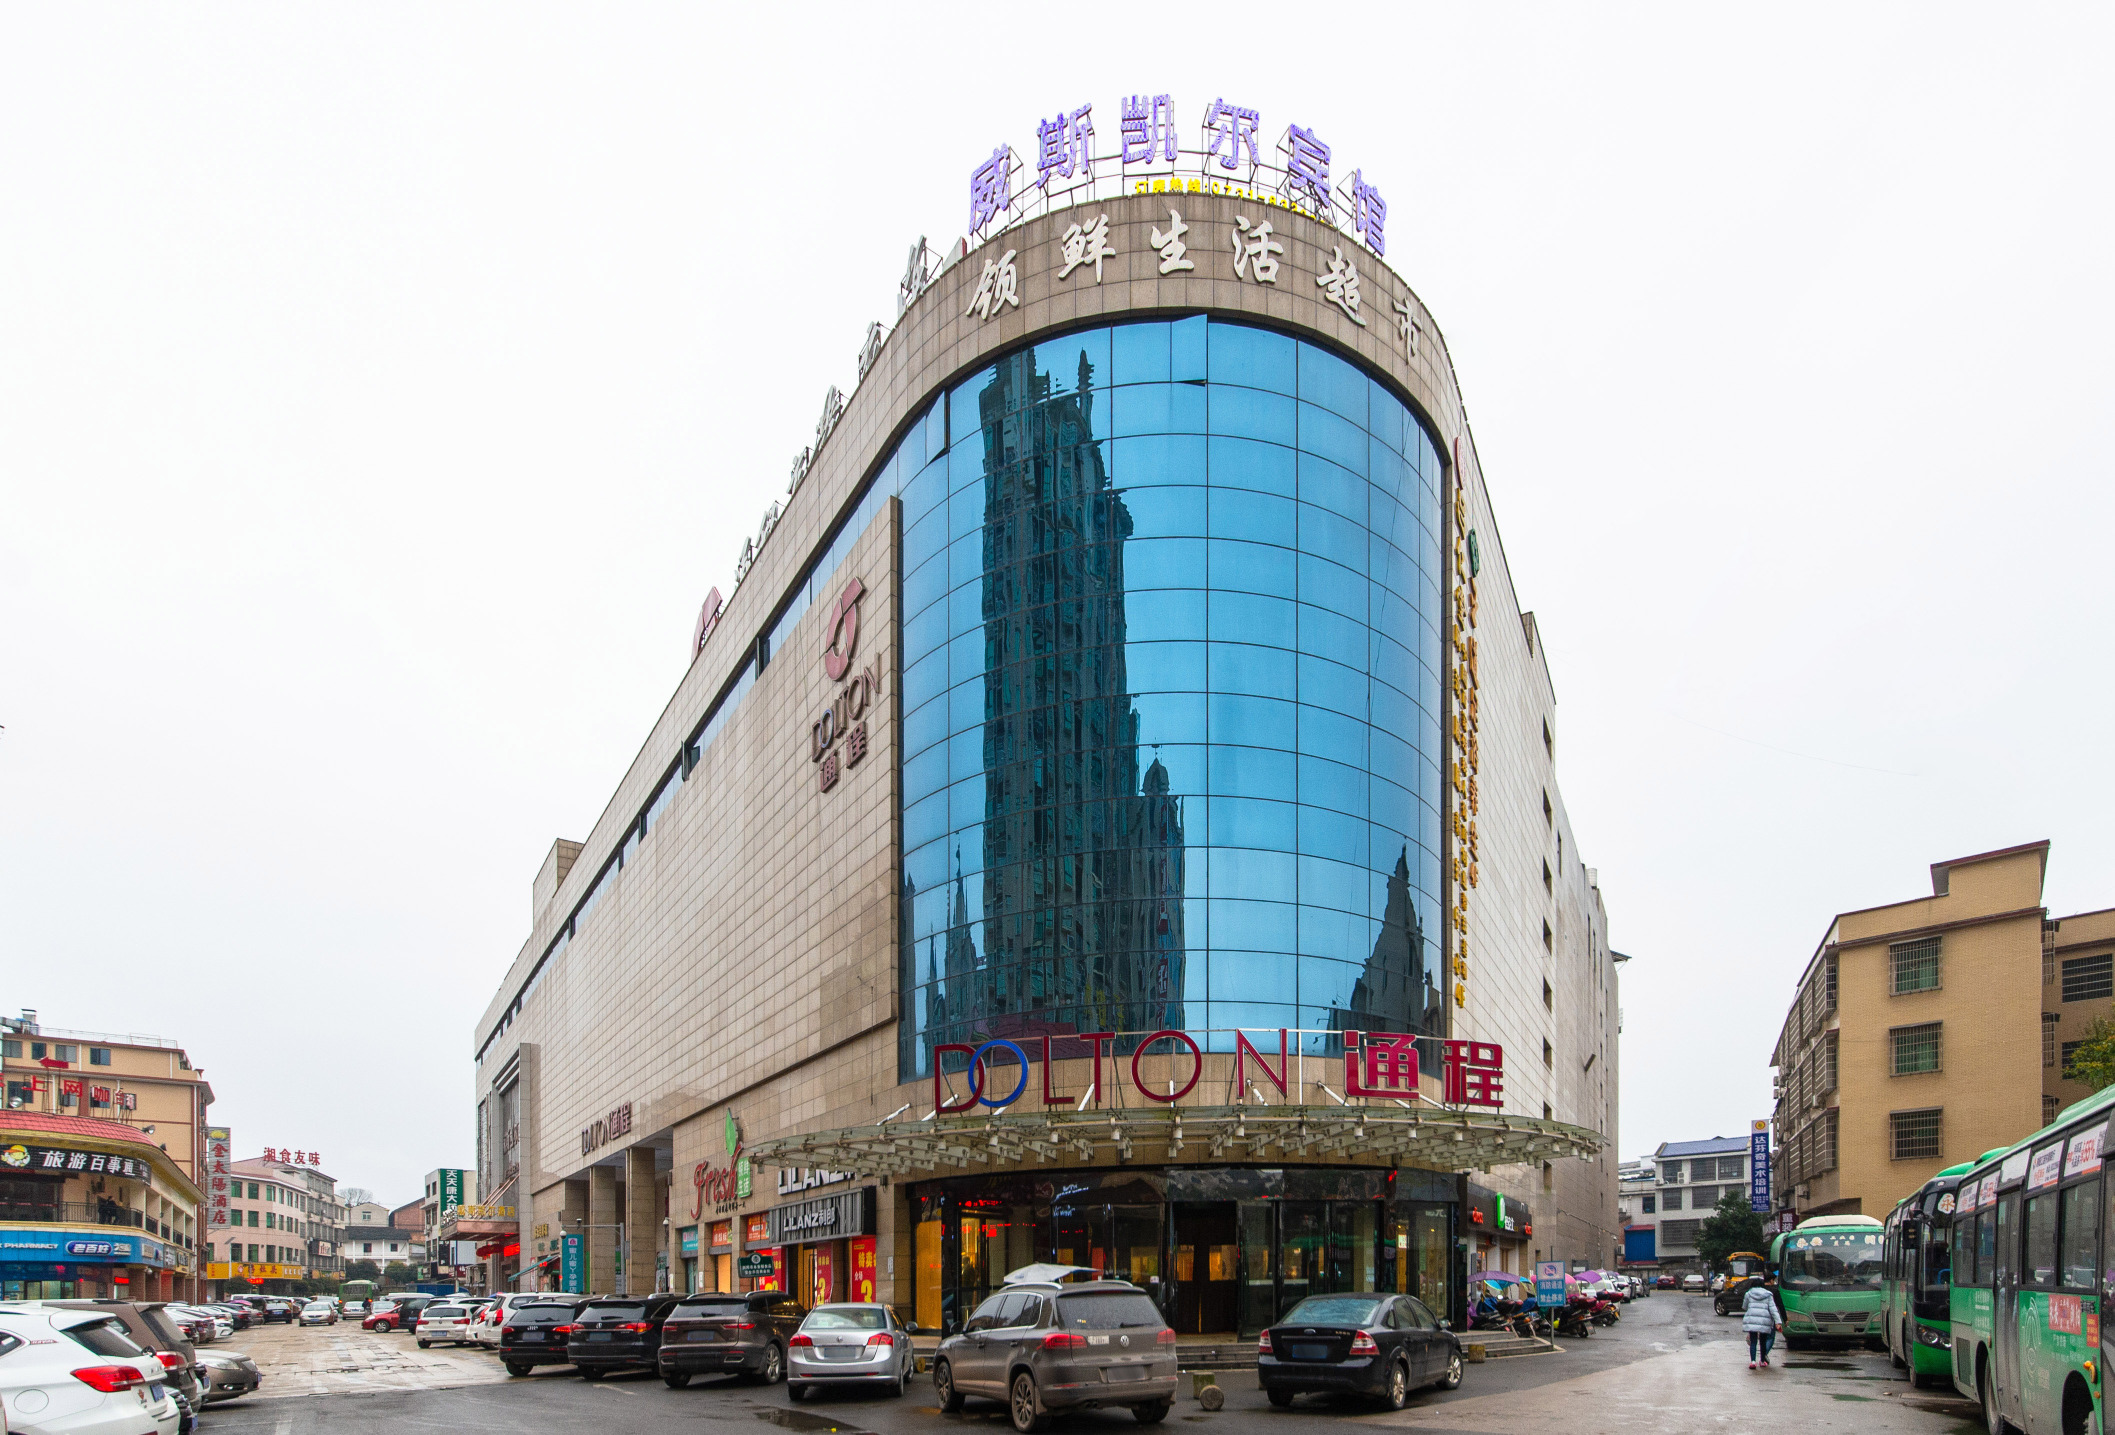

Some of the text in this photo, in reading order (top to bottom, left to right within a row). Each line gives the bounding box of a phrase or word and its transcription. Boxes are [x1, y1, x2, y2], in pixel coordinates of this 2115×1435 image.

[968, 93, 1387, 257] 威斯凯尔宾馆
[966, 209, 1423, 360] 领鲜生活超市
[811, 651, 882, 763] DOLTON
[934, 1028, 1504, 1113] DOLTON 通程
[38, 1150, 136, 1176] 旅游百事通
[263, 1147, 321, 1166] 湘食友味
[1754, 1136, 1767, 1195] 达芬奇美术培训
[1940, 1194, 1955, 1212] 永
[4, 1242, 59, 1250] PHARMACY
[73, 1243, 110, 1254] 老百姓
